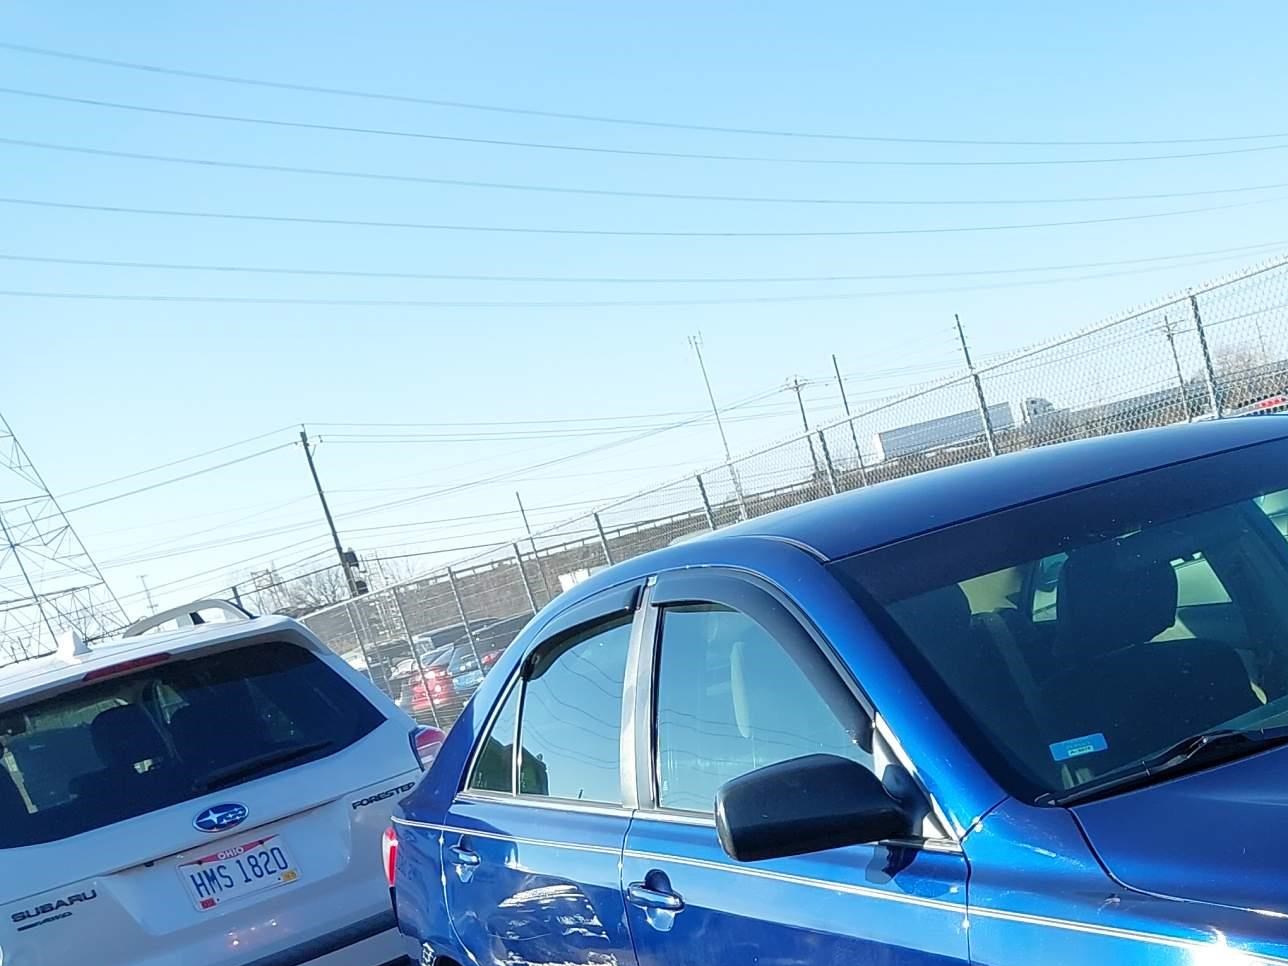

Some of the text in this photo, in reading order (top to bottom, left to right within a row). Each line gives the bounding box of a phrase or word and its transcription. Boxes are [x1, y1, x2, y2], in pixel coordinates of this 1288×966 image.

[352, 781, 416, 809] FORESTER
[218, 847, 244, 859] OHIO
[190, 847, 288, 898] HMS 1820
[11, 889, 97, 922] SUBARU
